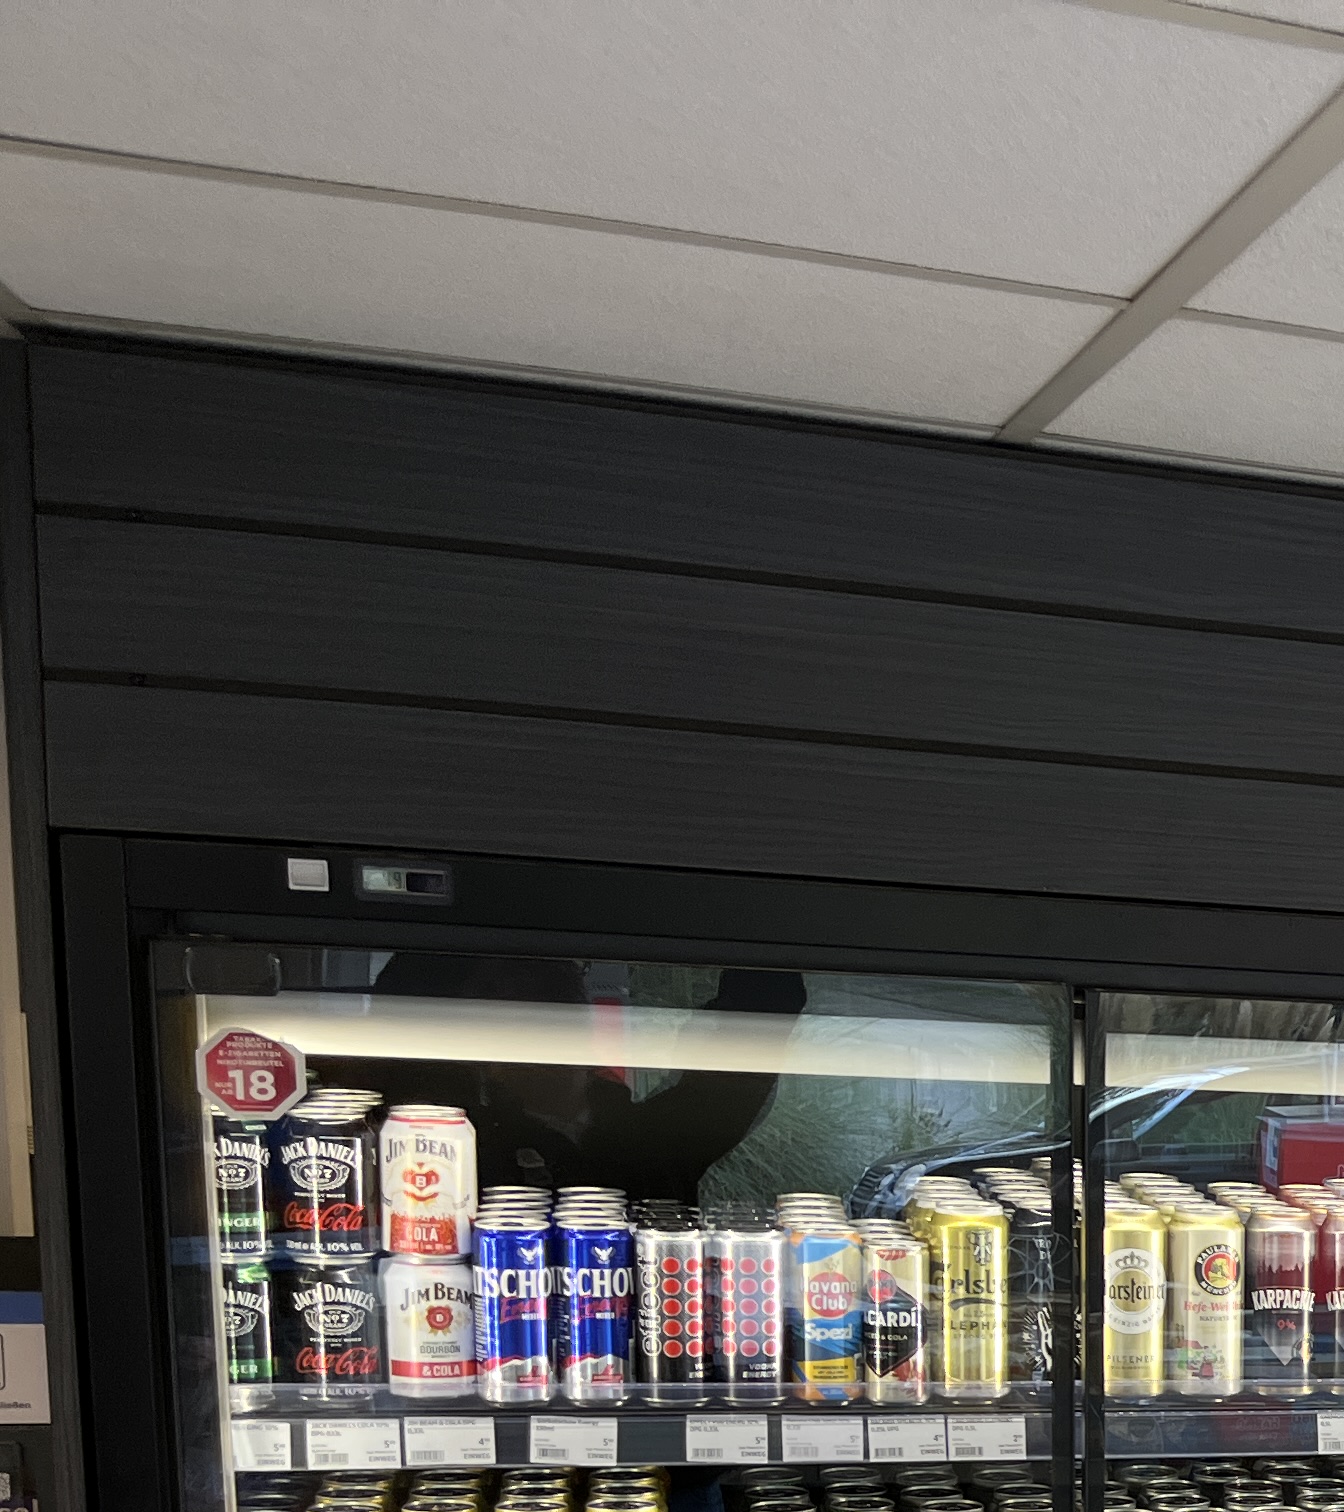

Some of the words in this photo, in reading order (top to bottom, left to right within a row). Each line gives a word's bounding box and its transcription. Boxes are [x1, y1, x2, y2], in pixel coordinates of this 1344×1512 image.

[228, 1069, 277, 1101] 18
[400, 1288, 433, 1311] JIM
[808, 1294, 848, 1311] Club
[805, 1323, 853, 1342] Spezi
[419, 1343, 461, 1355] BOURBON
